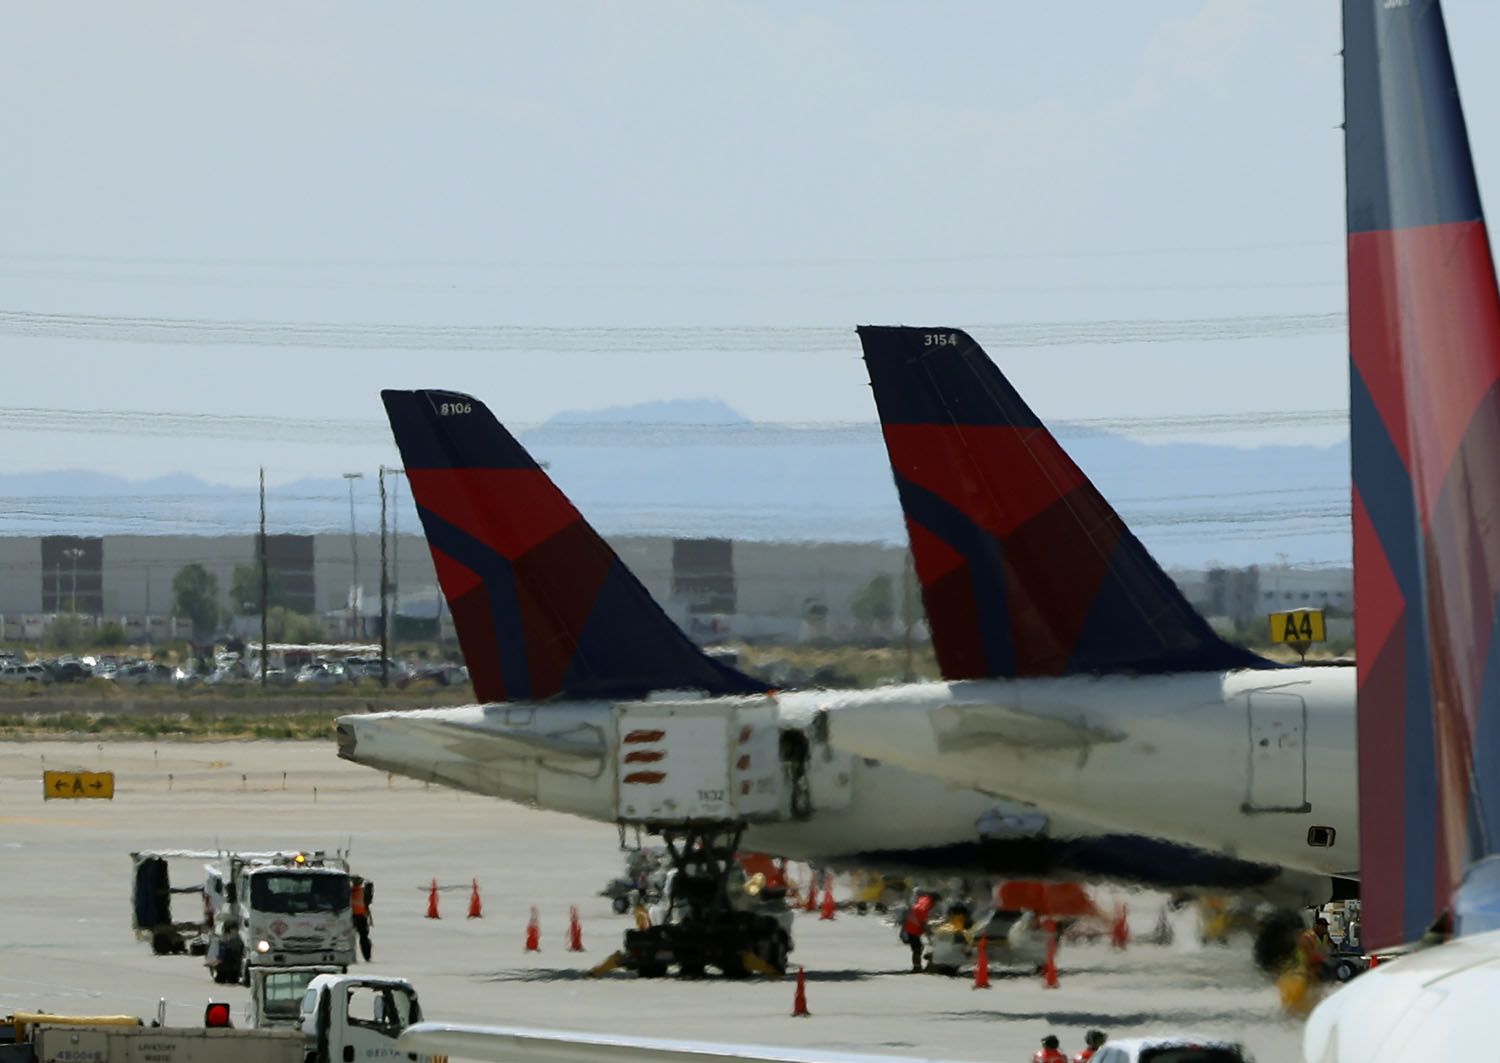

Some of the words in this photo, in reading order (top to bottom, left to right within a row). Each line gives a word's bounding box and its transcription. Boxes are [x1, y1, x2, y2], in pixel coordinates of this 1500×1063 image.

[924, 333, 957, 346] 3154
[440, 402, 472, 416] 8106
[1283, 612, 1313, 641] A4
[72, 778, 85, 793] A
